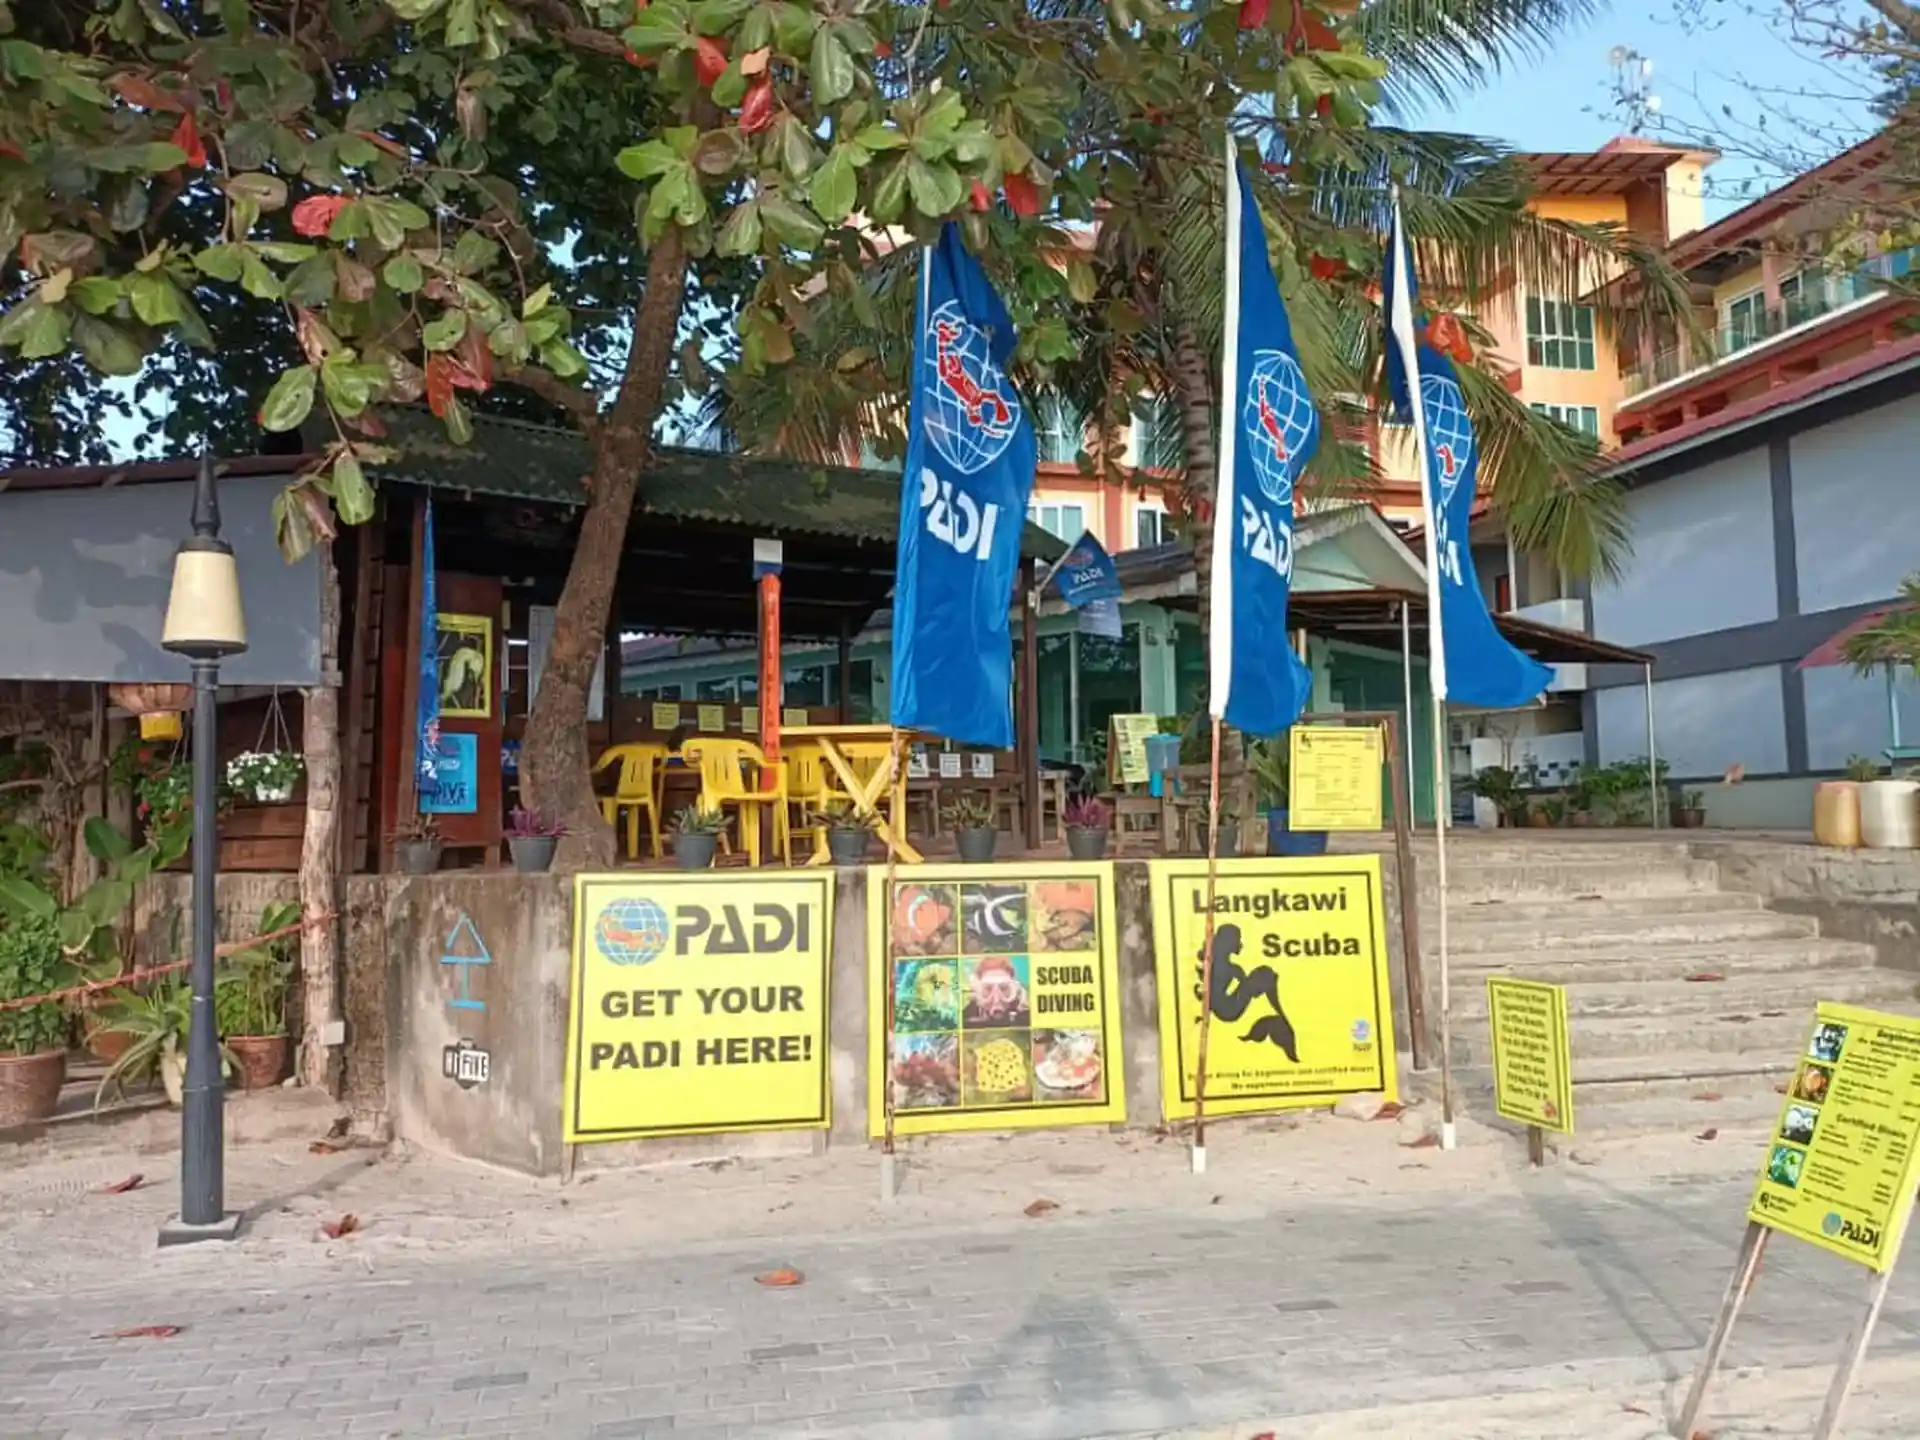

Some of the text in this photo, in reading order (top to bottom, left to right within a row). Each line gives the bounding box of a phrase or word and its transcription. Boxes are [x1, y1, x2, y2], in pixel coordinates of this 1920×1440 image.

[920, 466, 1000, 561] PADI
[1192, 887, 1347, 919] Langkawi
[675, 902, 811, 956] PADI
[1261, 932, 1361, 959] Scuba
[1036, 965, 1094, 986] SCUBA
[600, 985, 805, 1019] GET YOUR
[1037, 993, 1096, 1014] DIVING
[590, 1035, 812, 1071] PADI HERE!
